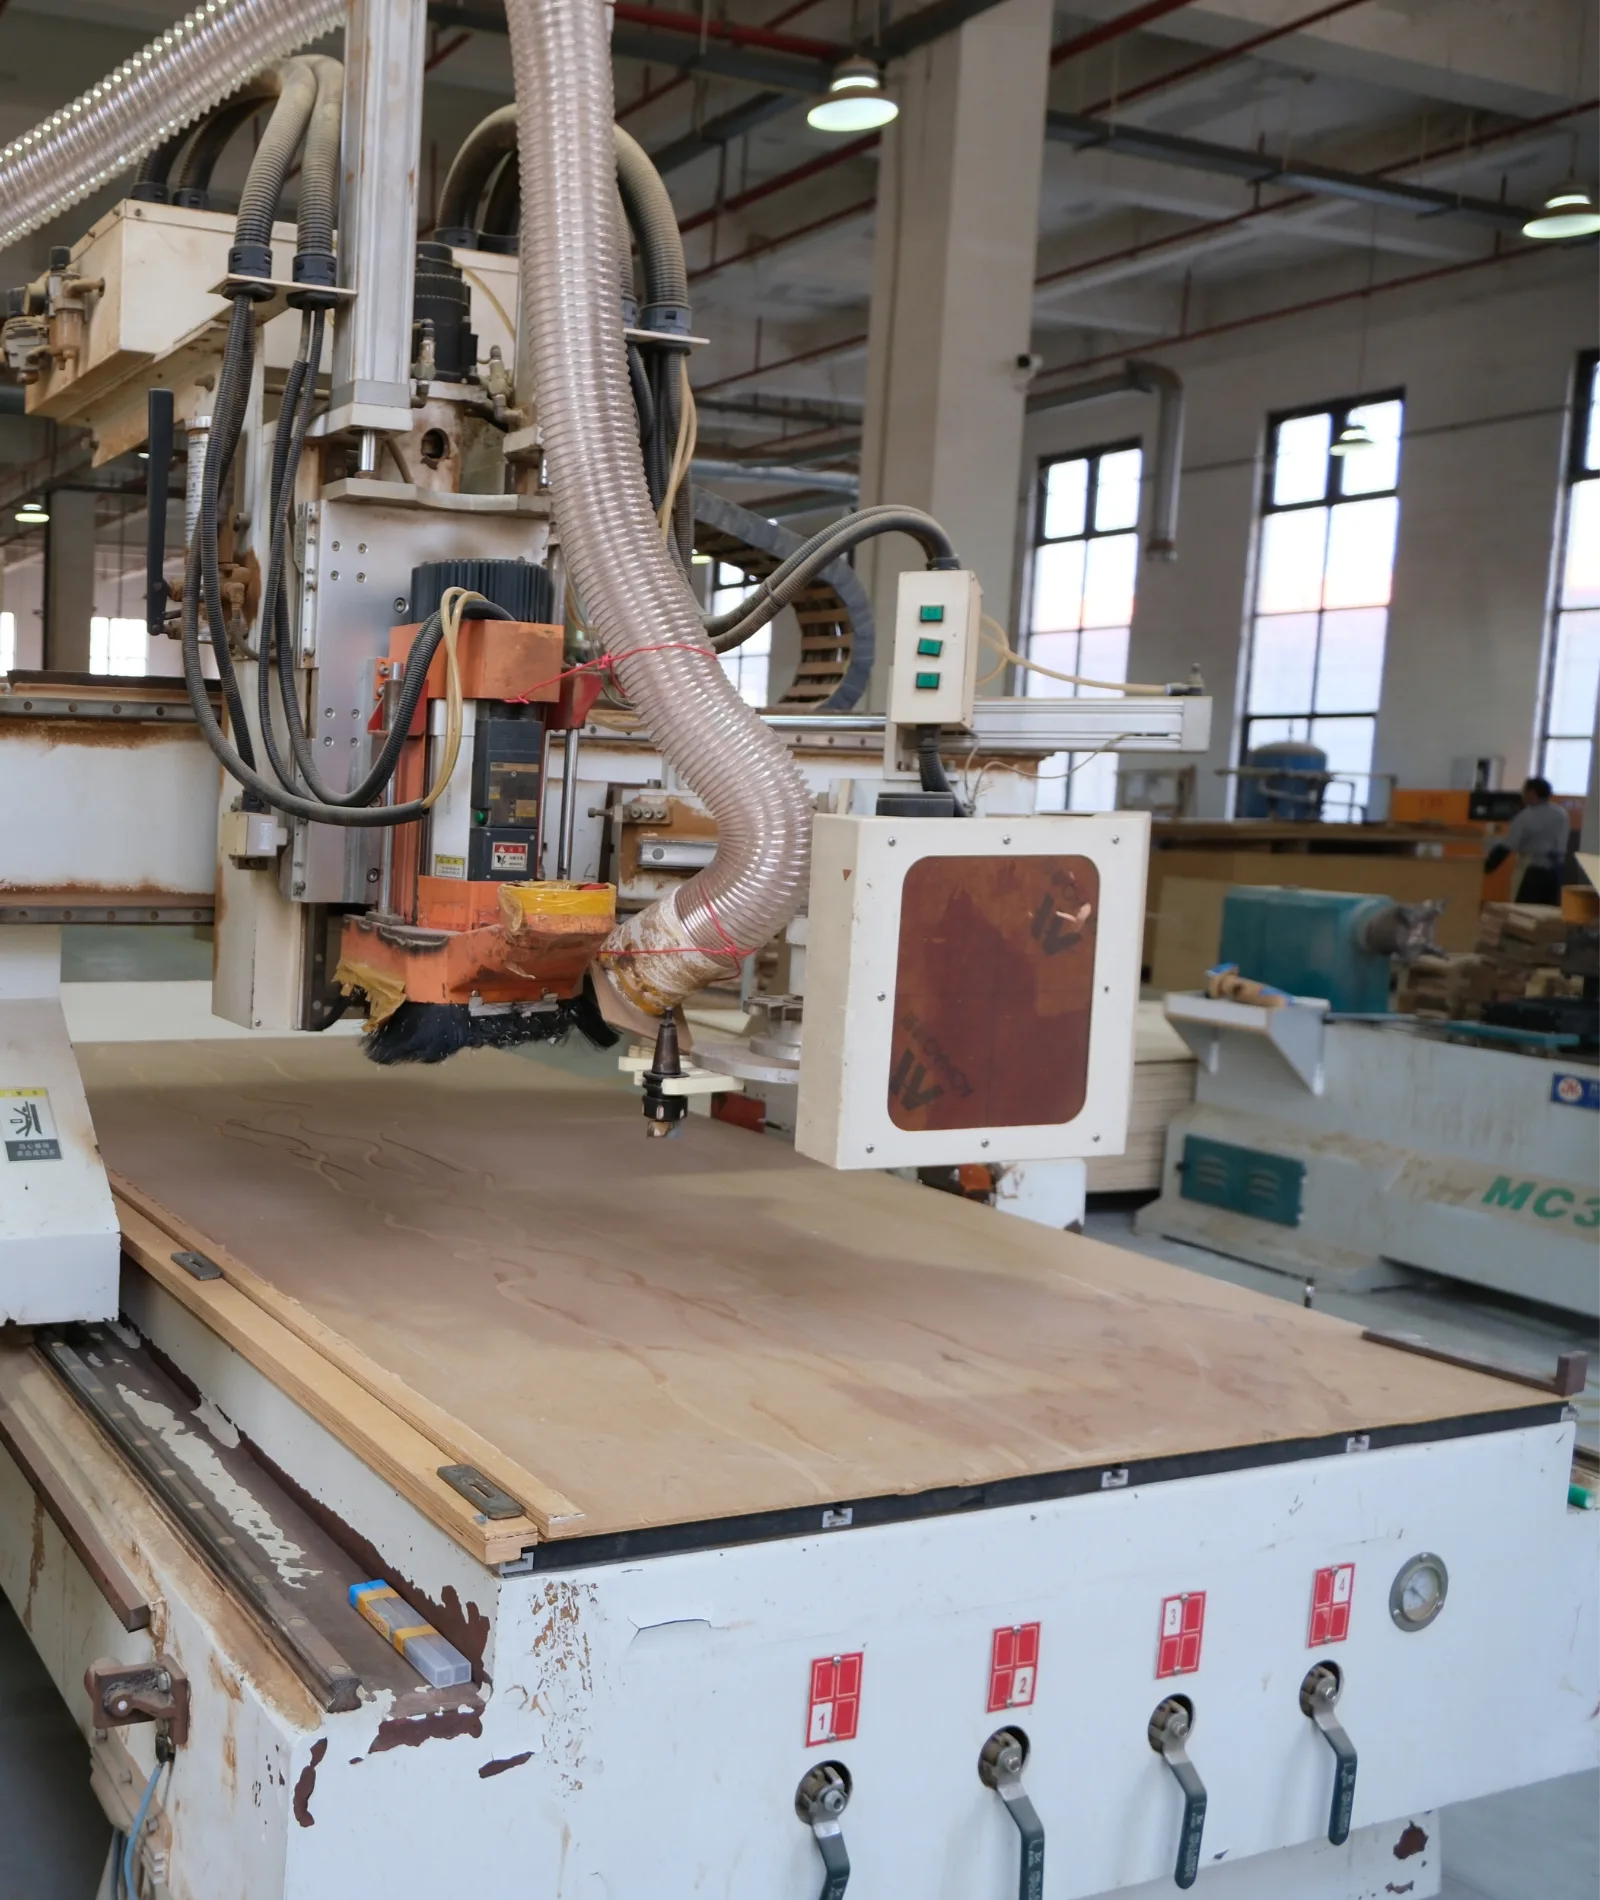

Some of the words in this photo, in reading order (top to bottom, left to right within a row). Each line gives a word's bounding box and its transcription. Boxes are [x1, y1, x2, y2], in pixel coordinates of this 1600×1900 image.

[1339, 1577, 1346, 1592] 4
[1169, 1608, 1176, 1625] 3
[1019, 1677, 1027, 1693] 2
[819, 1713, 825, 1730] 1
